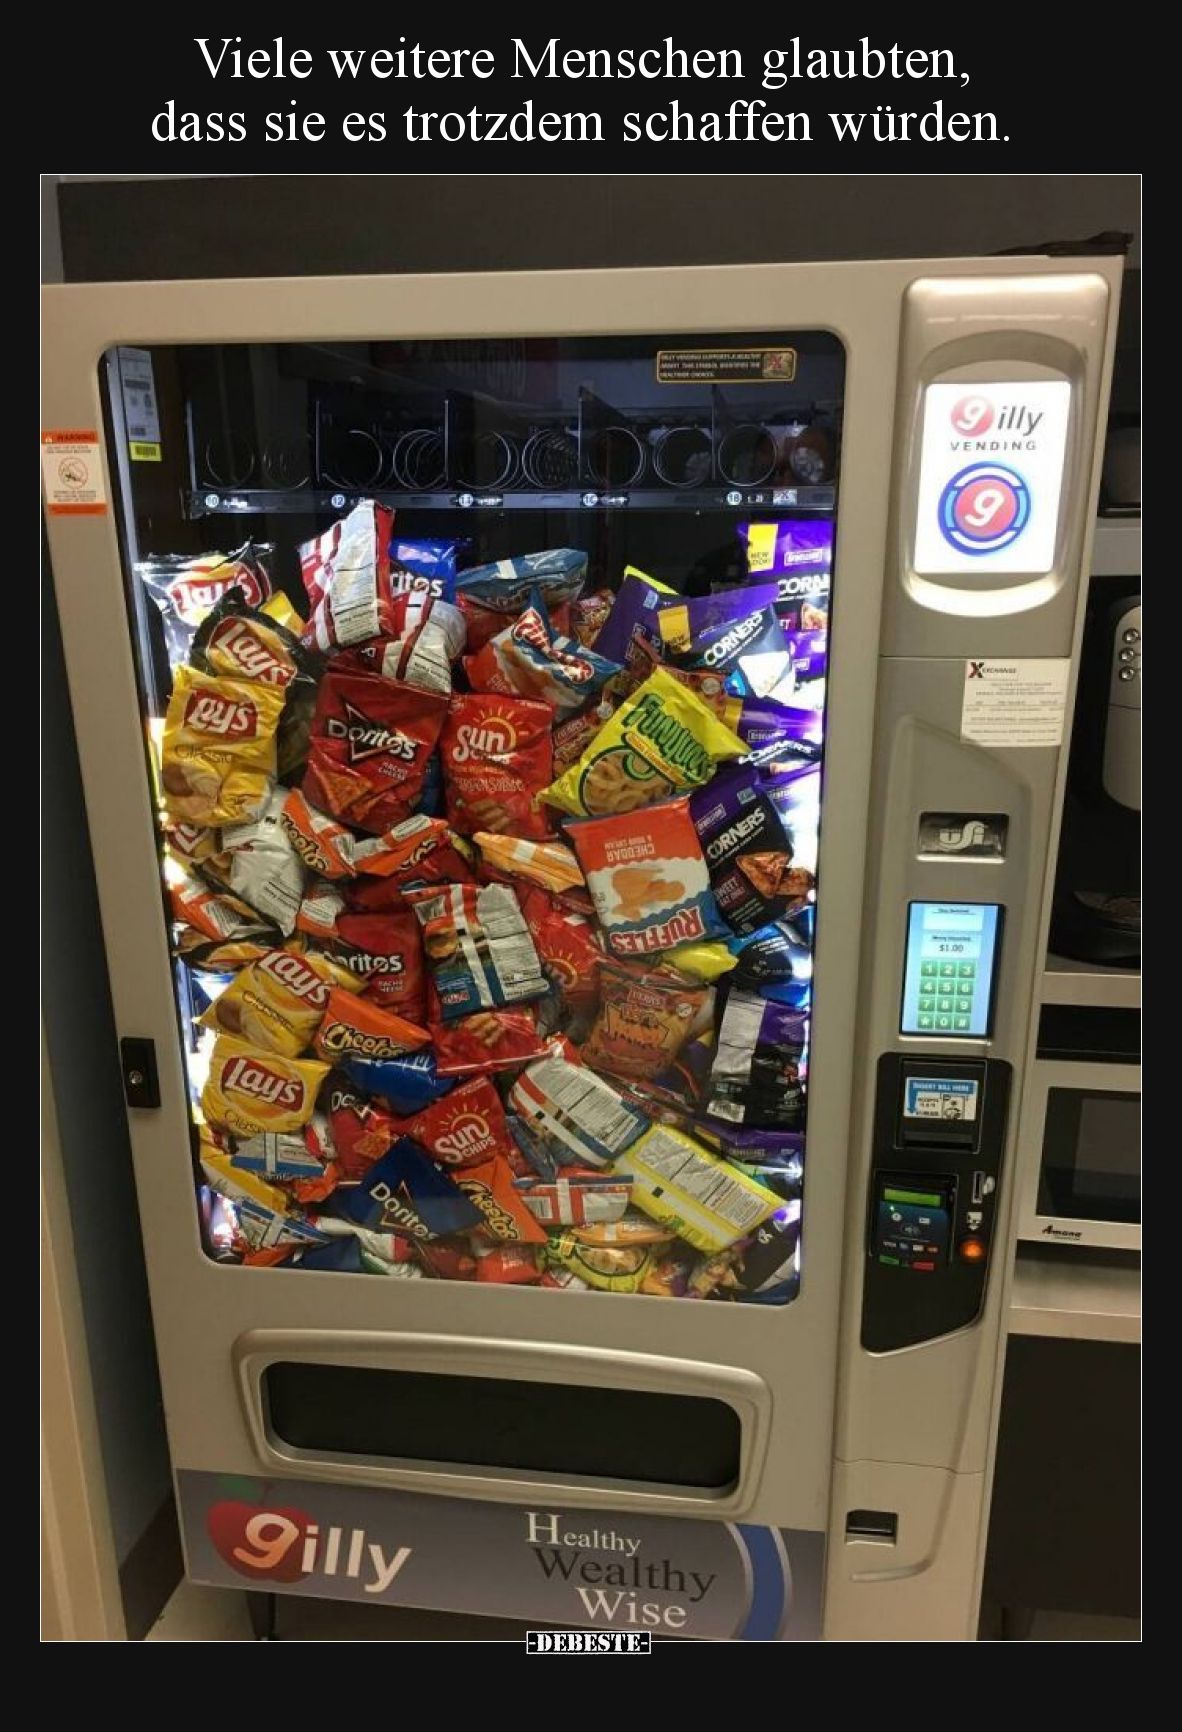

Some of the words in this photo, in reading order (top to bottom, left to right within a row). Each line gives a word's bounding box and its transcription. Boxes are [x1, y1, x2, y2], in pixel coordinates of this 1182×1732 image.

[950, 440, 1036, 452] VENDING
[703, 611, 763, 666] CORNERS
[327, 718, 417, 760] Doritos
[452, 724, 507, 762] Sun
[605, 841, 656, 862] CHEDDAR
[707, 806, 766, 860] CORNERS
[609, 904, 705, 954] RUFFLES
[939, 944, 964, 952] $1.00
[434, 1123, 486, 1163] Sun
[460, 1135, 497, 1158] CHIPS
[232, 1512, 413, 1594] gilly
[524, 1511, 643, 1557] Healthy
[532, 1545, 718, 1603] Wealthy
[575, 1587, 689, 1629] Wise
